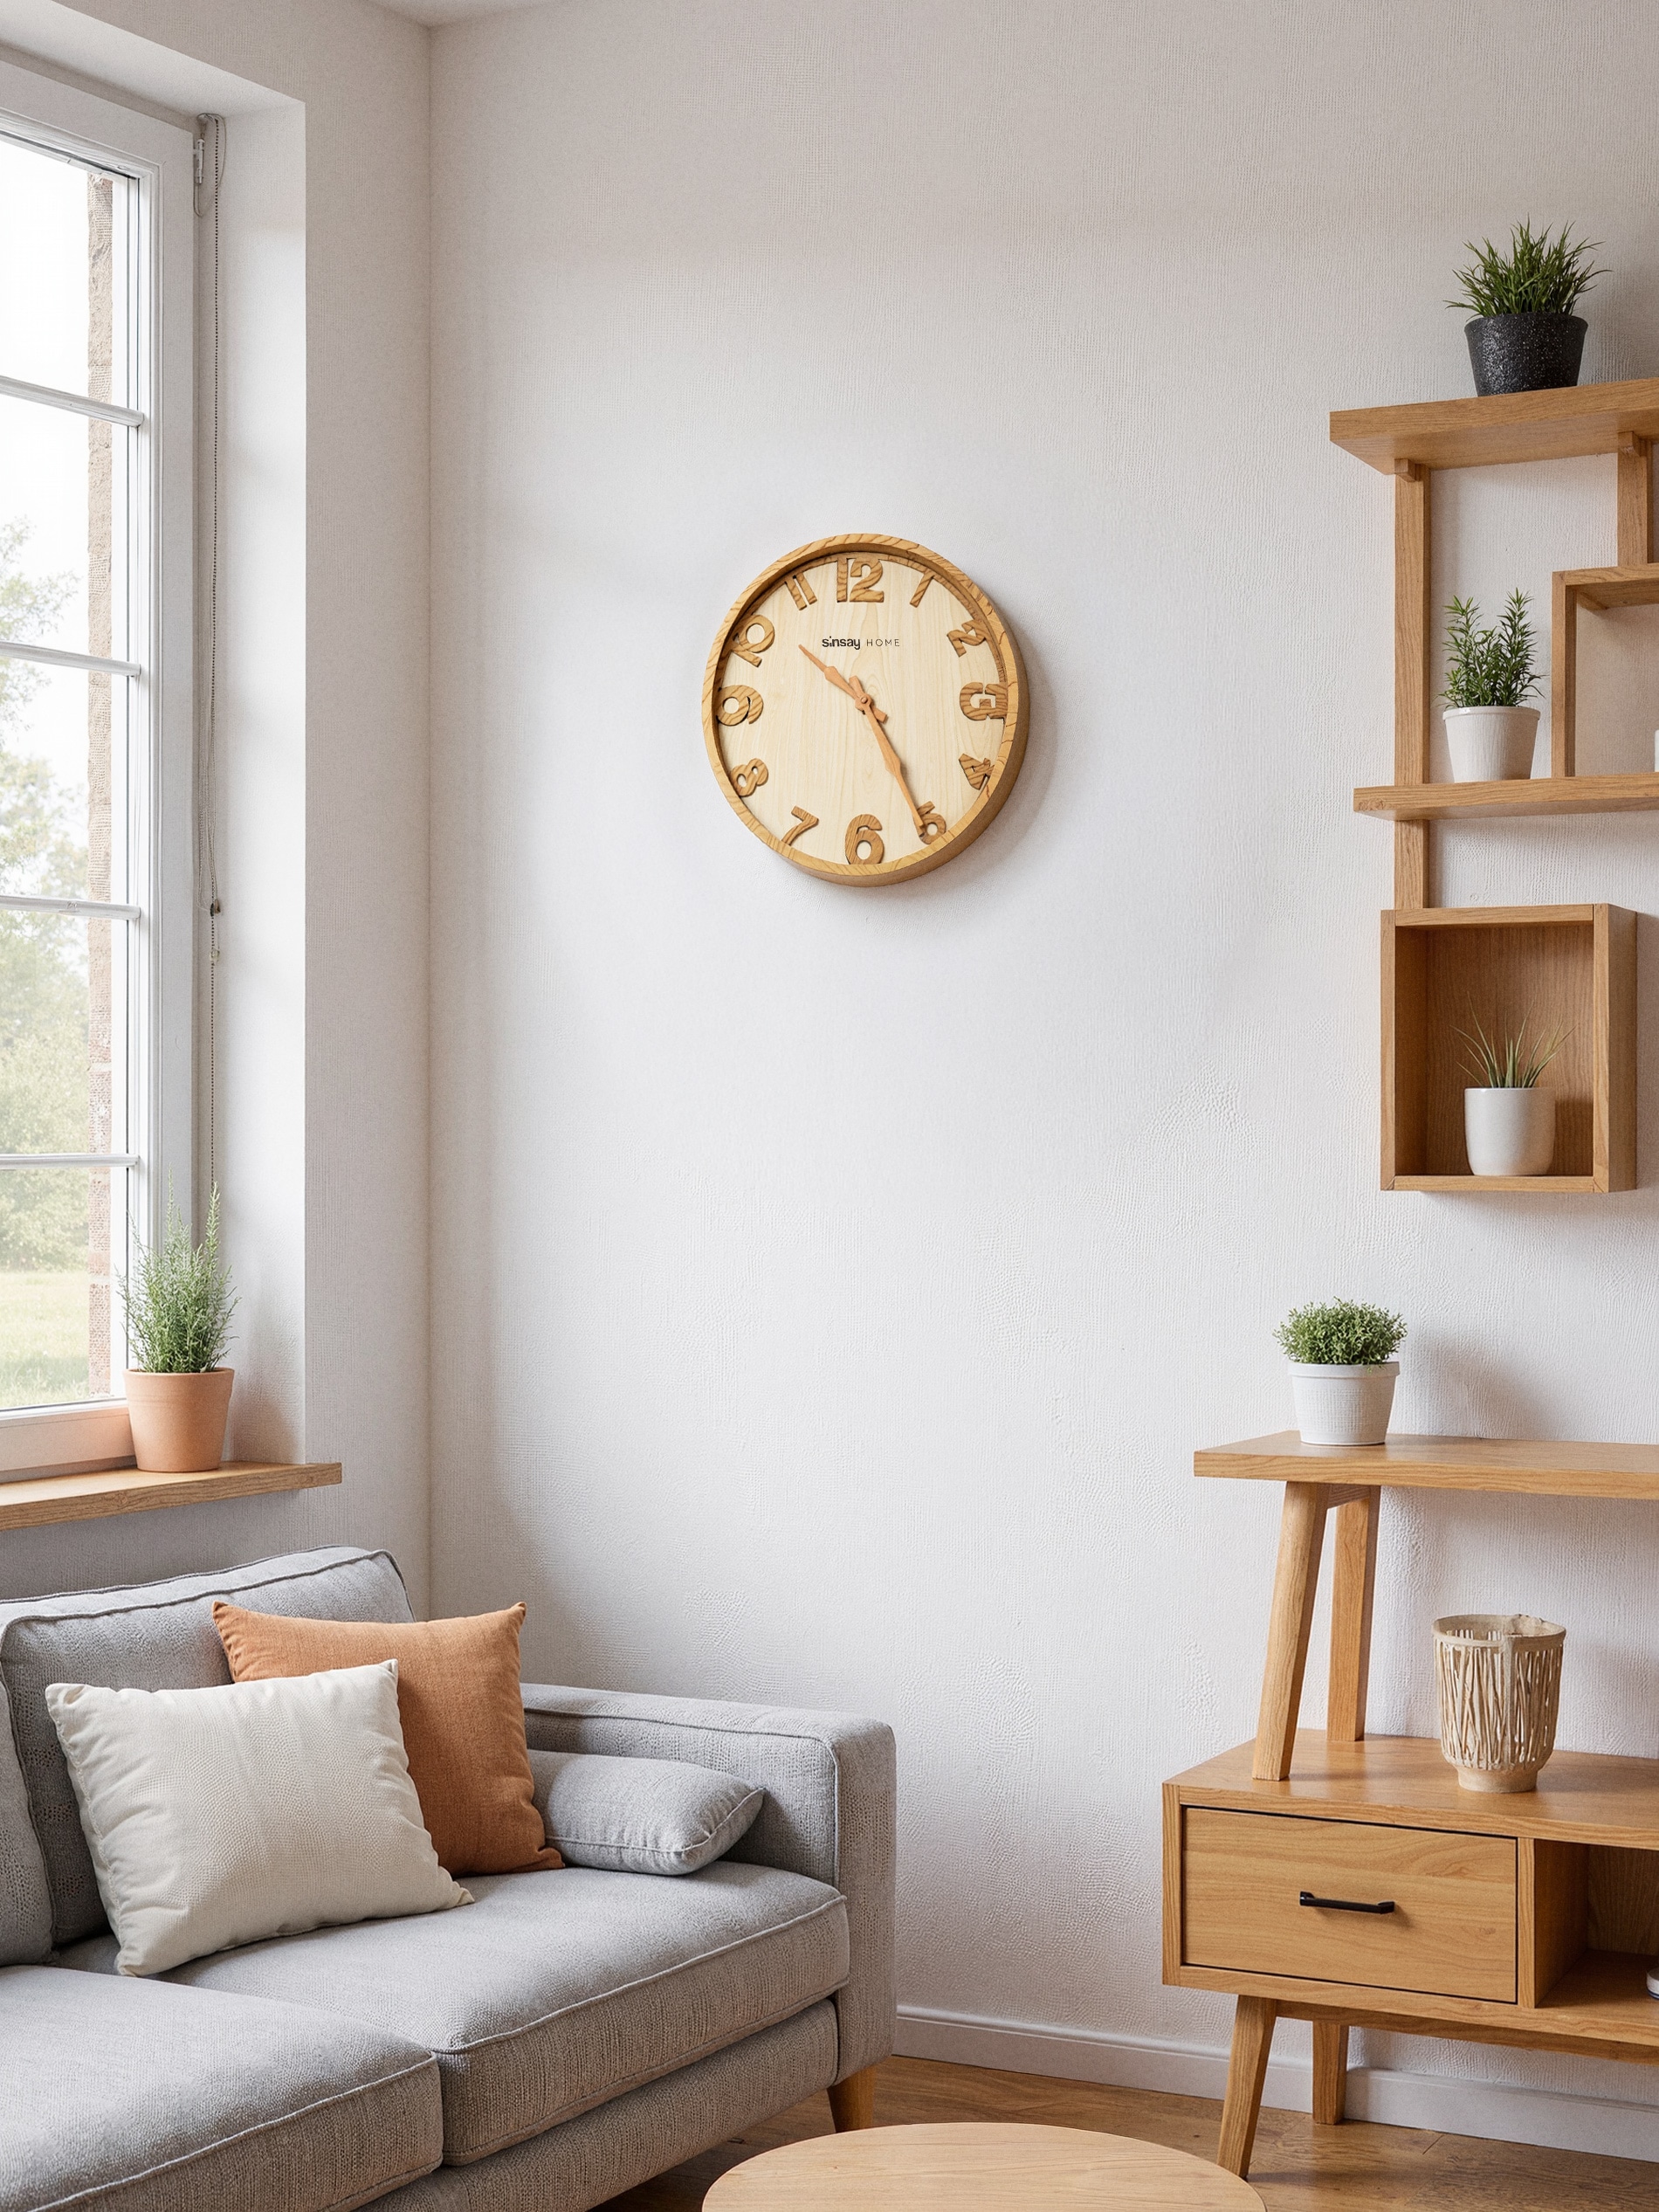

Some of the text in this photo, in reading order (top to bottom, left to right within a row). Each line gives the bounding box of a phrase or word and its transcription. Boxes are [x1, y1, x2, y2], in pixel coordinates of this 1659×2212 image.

[785, 572, 817, 610] 11
[836, 557, 884, 603] 12
[909, 569, 935, 608] 1
[822, 636, 900, 650] sinsay HOME
[947, 619, 988, 658] 2
[716, 685, 764, 727] 9
[730, 758, 768, 797] 8
[781, 805, 819, 846] 7
[844, 813, 885, 865] 6
